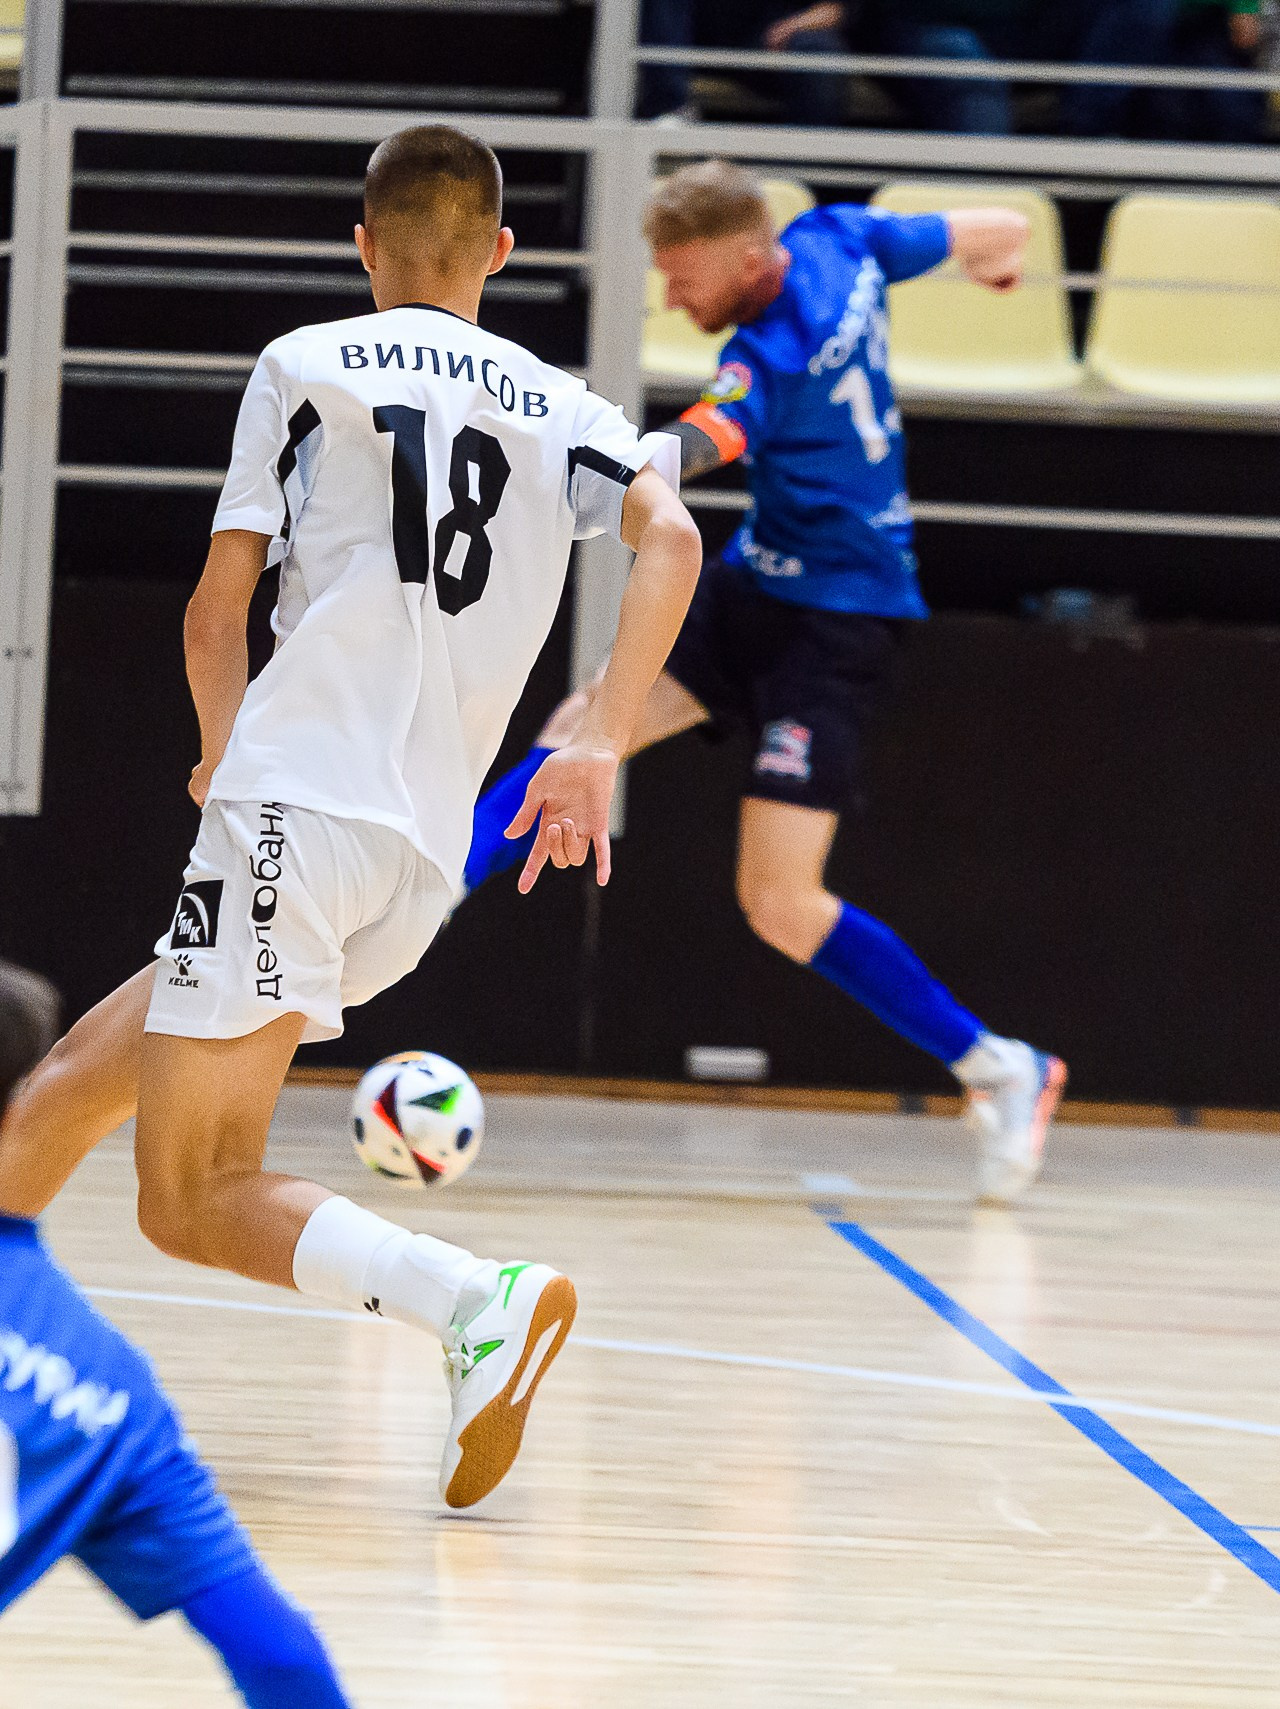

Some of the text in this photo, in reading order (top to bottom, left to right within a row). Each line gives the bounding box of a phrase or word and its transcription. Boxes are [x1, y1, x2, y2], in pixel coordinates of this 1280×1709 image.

[340, 343, 549, 418] ВИЛИСОВ
[372, 404, 512, 617] 18
[168, 976, 200, 989] KELME
